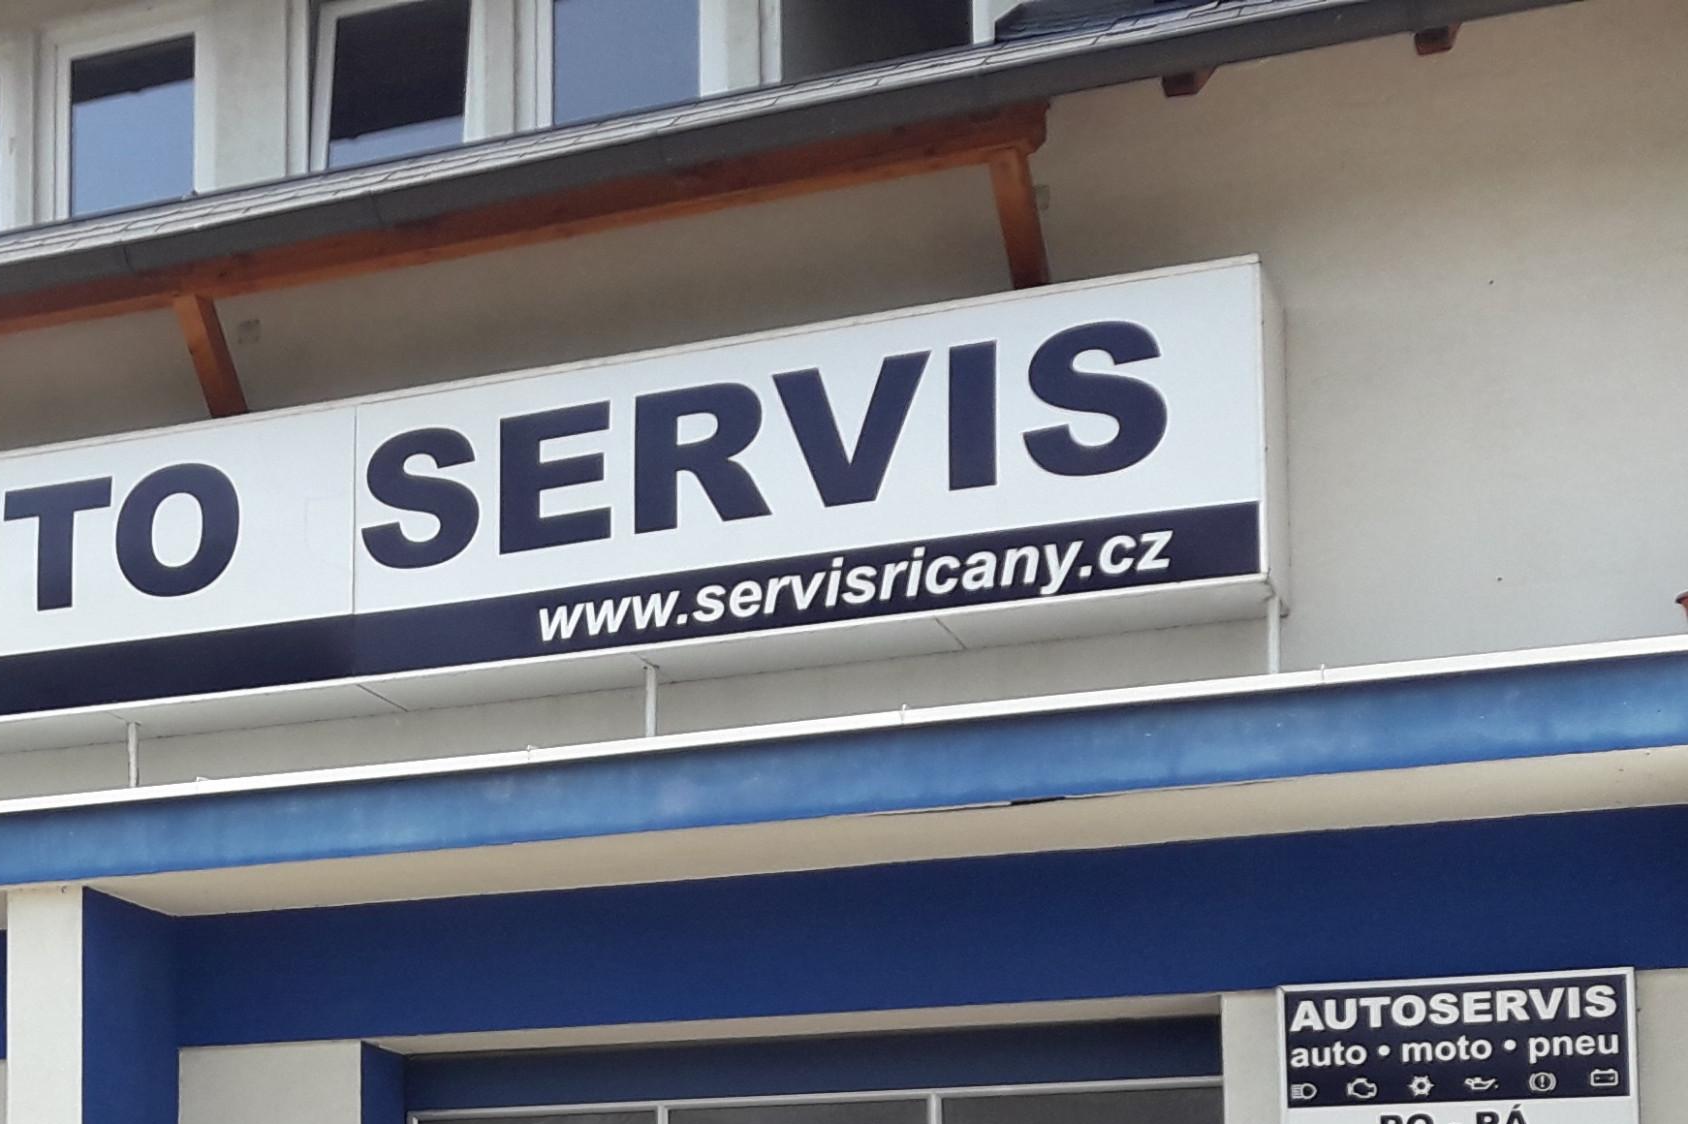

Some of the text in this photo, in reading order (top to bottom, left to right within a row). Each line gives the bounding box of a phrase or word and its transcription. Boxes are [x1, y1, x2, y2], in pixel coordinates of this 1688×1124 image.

[362, 321, 1169, 570] SERVIS
[538, 530, 1172, 643] www.servisricany.cz
[1289, 984, 1617, 1032] AUTOSERVIS
[1290, 1033, 1619, 1068] auto moto pneu
